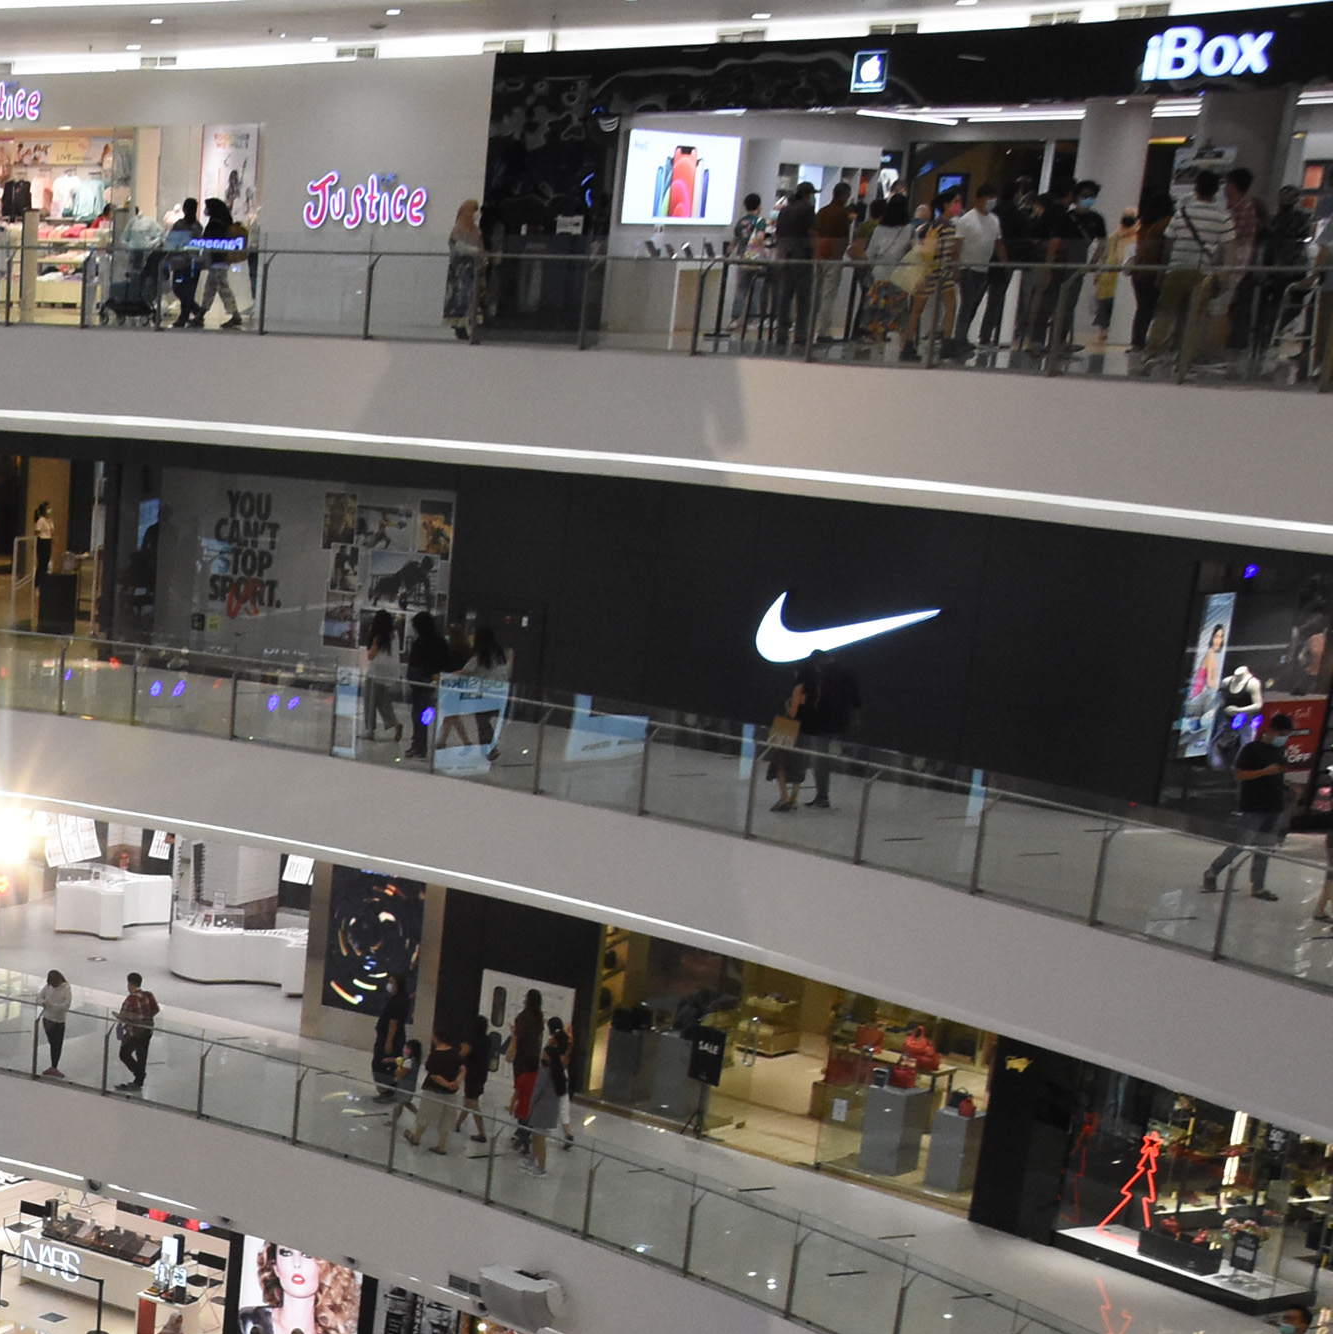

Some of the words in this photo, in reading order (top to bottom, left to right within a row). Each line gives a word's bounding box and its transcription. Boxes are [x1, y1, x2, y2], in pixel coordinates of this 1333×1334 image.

[1141, 26, 1274, 81] iBox
[303, 170, 427, 230] Justice
[227, 490, 272, 520] YOU
[210, 547, 272, 577] STOP
[698, 1040, 719, 1055] SALE
[23, 1239, 81, 1282] NARS
